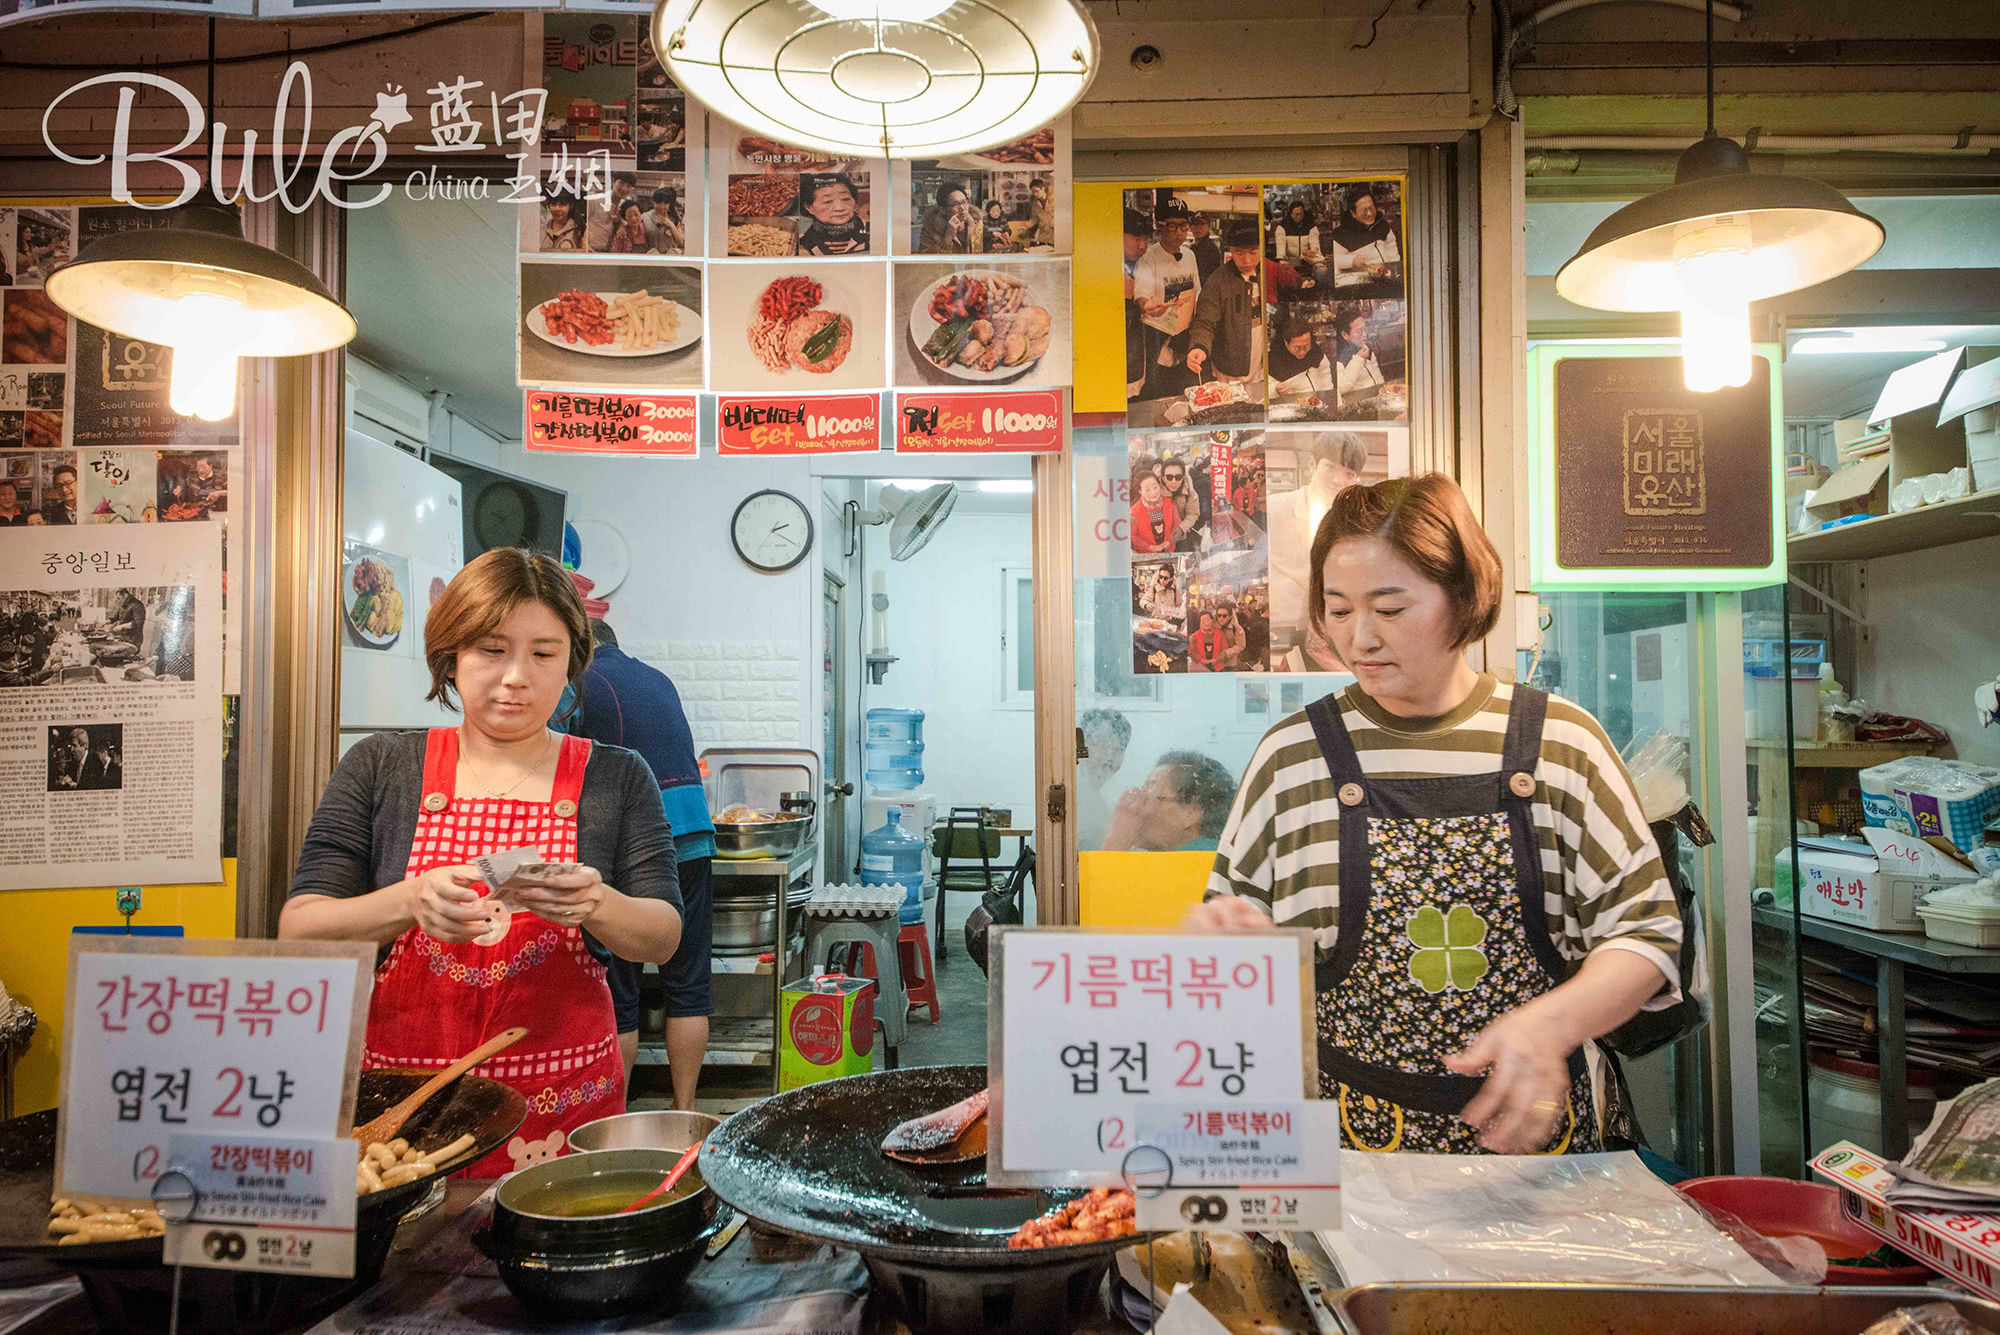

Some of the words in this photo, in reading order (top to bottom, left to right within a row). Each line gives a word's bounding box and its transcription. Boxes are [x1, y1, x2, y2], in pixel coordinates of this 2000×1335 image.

[535, 395, 641, 422] 기름떡볶이
[640, 401, 695, 421] 3000원
[724, 402, 805, 431] 빈대떡
[903, 405, 939, 436] 전
[938, 412, 976, 434] Set
[982, 407, 1058, 435] 11,000원
[534, 421, 638, 445] 간장떡볶이
[639, 424, 694, 445] 3000원
[750, 425, 795, 450] Set
[806, 414, 875, 439] 11,000원
[1632, 417, 1696, 448] 서울
[1633, 449, 1695, 474] 미래
[1634, 475, 1696, 507] 유산
[41, 551, 137, 575] 중앙일보
[1816, 876, 1868, 910] 애호박
[1030, 953, 1275, 1010] 기름떡볶이
[96, 974, 329, 1038] 간장떡볶이
[1060, 1041, 1151, 1095] 엽전
[1174, 1039, 1255, 1096] 2냥
[111, 1066, 192, 1124] 엽전
[212, 1066, 296, 1128] 2냥
[1183, 1111, 1292, 1137] 기름떡볶이
[209, 1144, 314, 1175] 간장떡볶이
[1895, 1215, 1944, 1263] SAM
[1952, 1246, 1992, 1289] JIN
